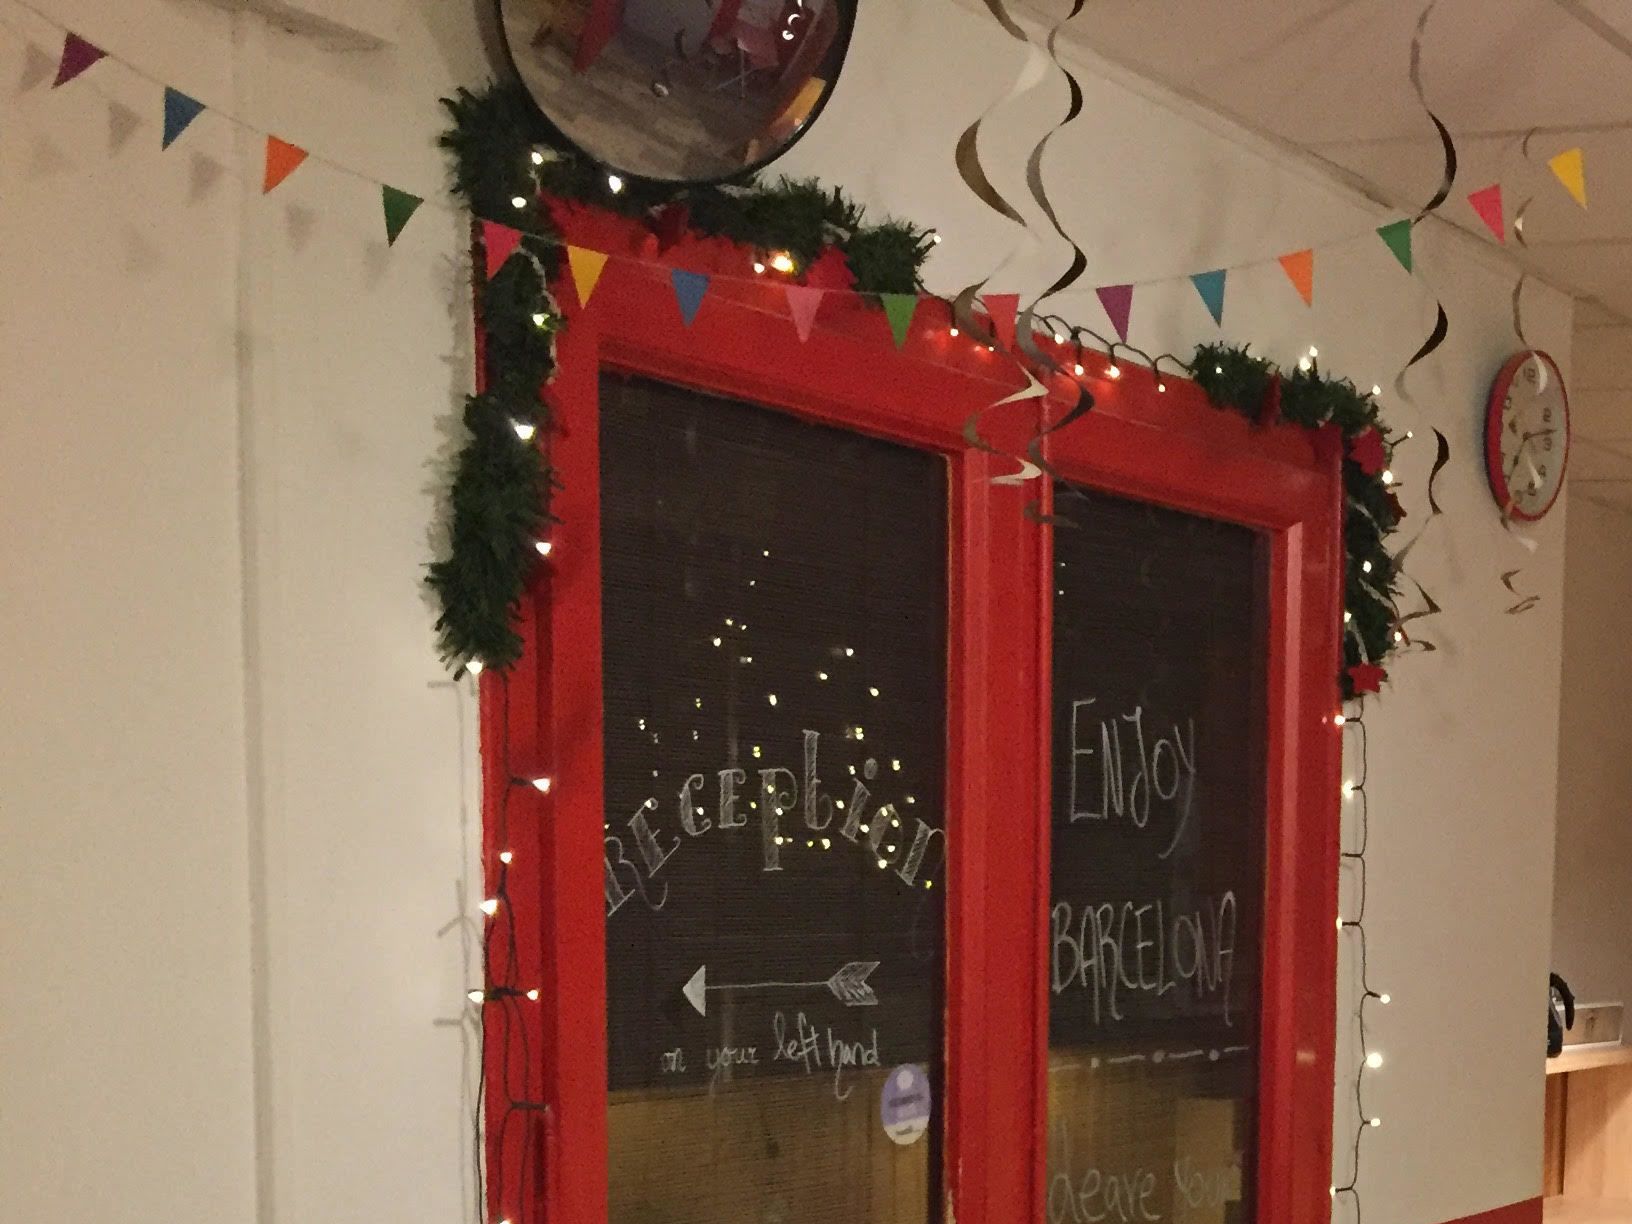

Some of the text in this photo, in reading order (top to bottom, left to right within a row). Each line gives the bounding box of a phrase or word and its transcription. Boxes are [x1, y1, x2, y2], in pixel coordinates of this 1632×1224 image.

[1070, 697, 1196, 860] ENJOY
[1051, 890, 1237, 1027] BARCELONA
[705, 1045, 760, 1098] your
[774, 1011, 822, 1075] left
